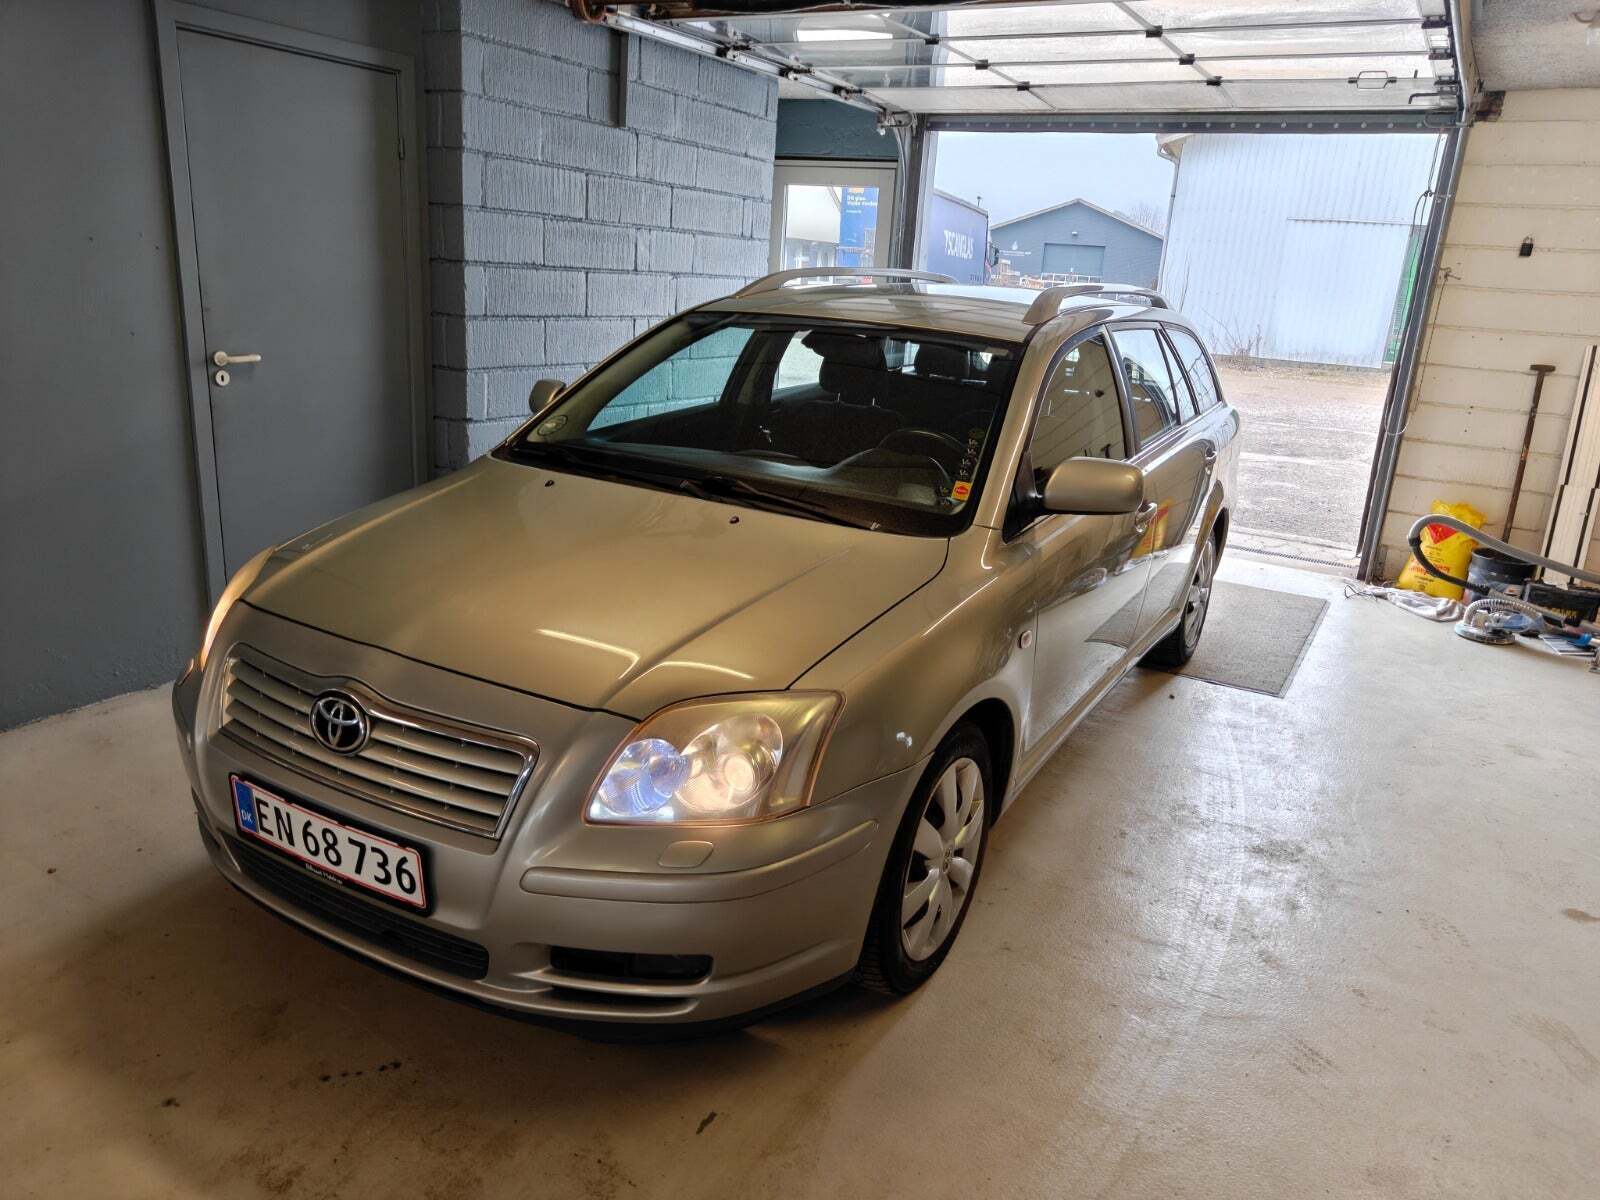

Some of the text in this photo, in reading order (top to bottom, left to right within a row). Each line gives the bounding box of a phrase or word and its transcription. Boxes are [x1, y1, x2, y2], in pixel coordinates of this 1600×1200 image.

[240, 808, 252, 823] DK
[255, 797, 295, 847] EN
[302, 820, 342, 866] 68
[348, 837, 416, 894] 736
